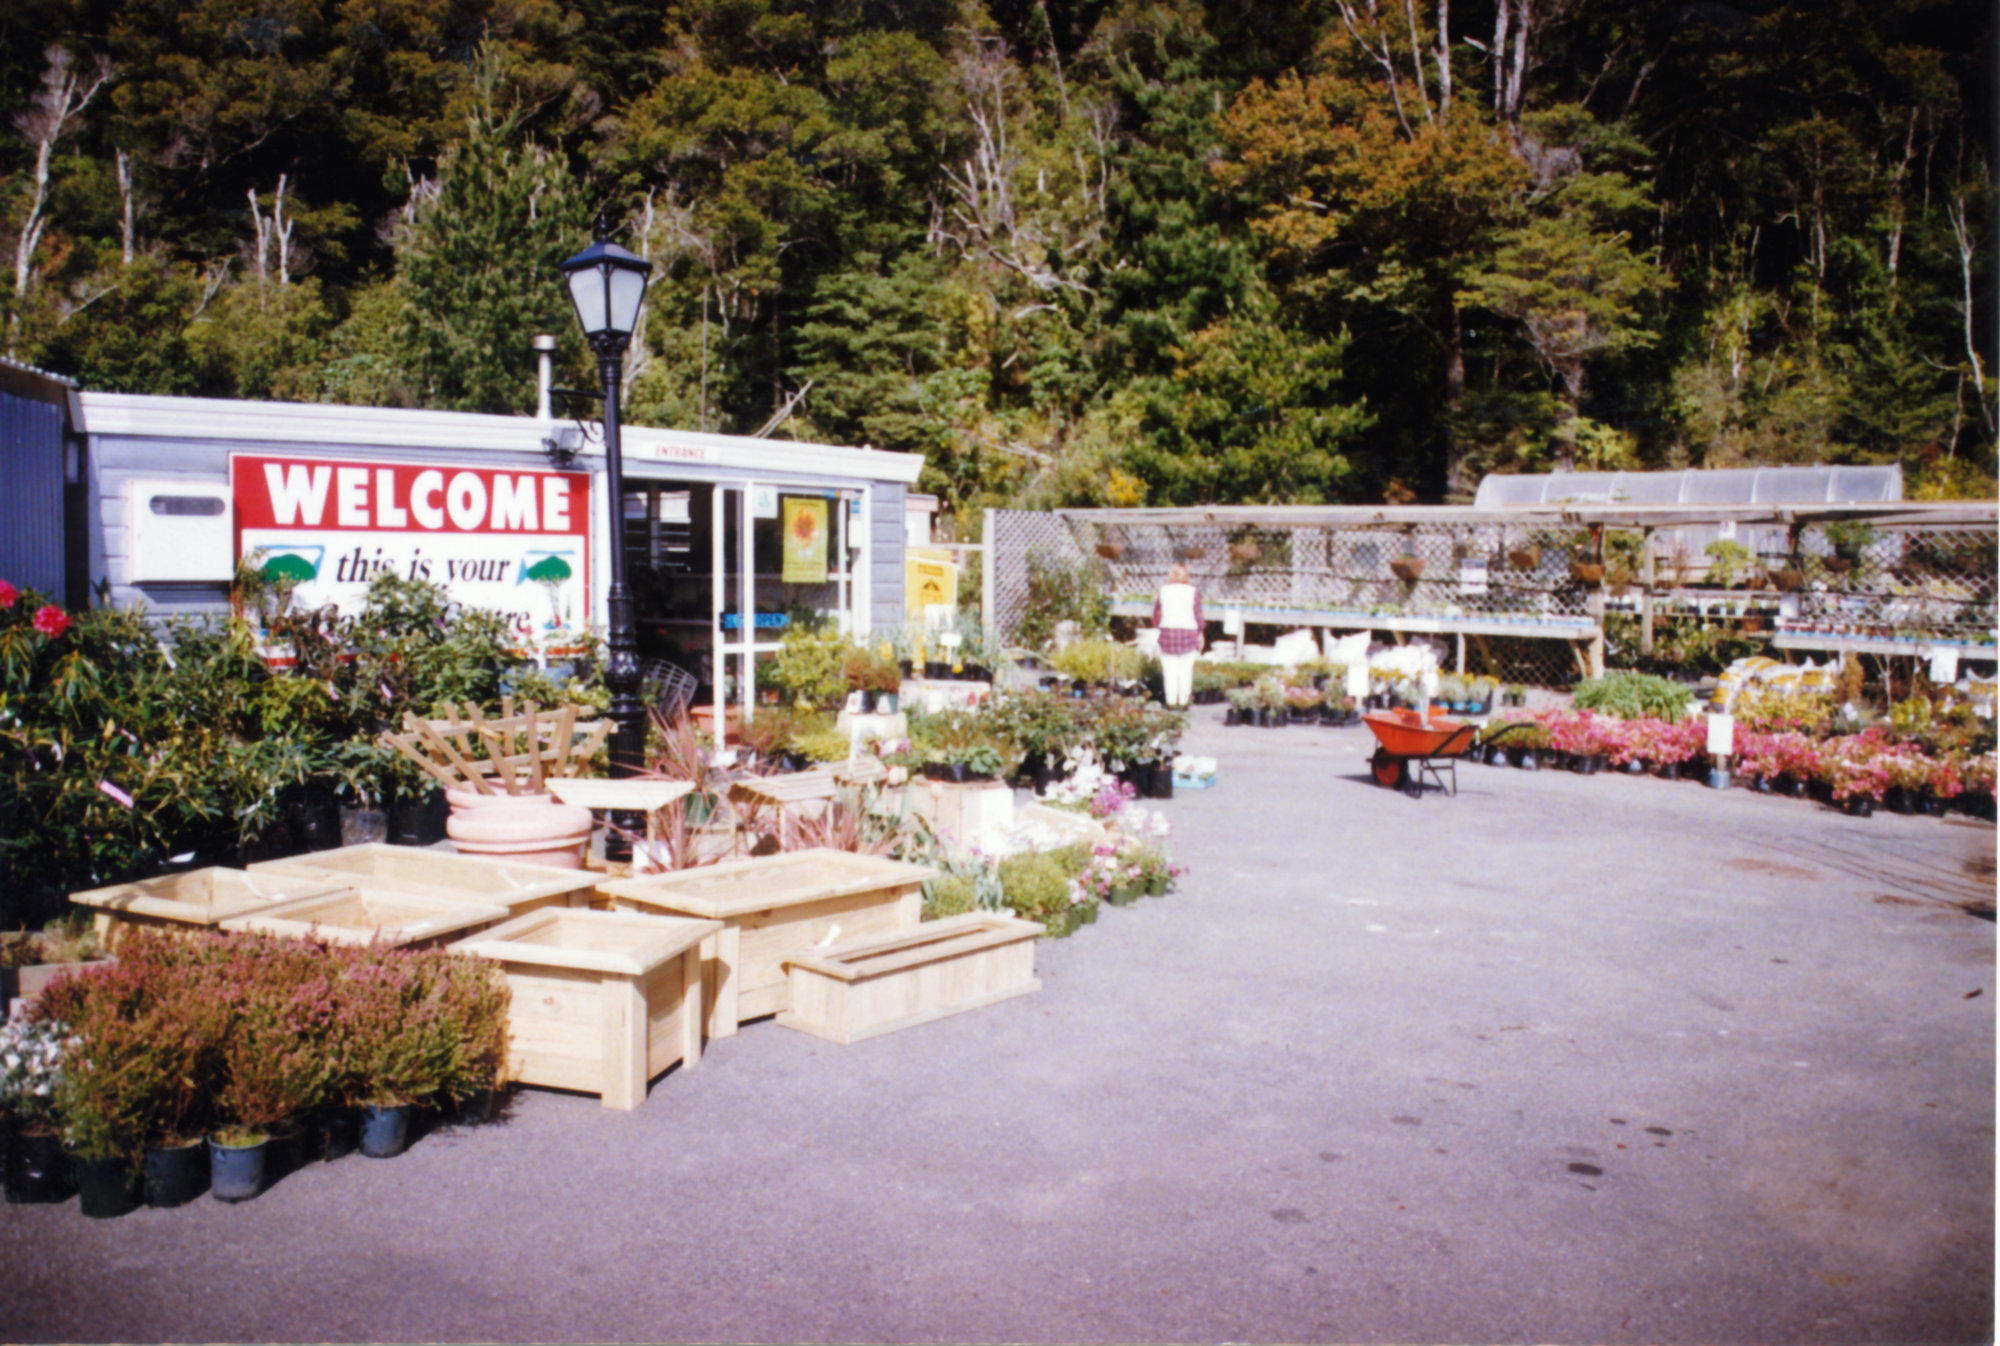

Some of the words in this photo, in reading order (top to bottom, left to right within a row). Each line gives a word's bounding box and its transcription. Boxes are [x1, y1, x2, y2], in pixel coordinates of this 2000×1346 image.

[655, 445, 706, 459] ENTRANCE
[263, 463, 571, 531] WELCOME
[409, 547, 432, 582] is
[442, 558, 511, 589] your
